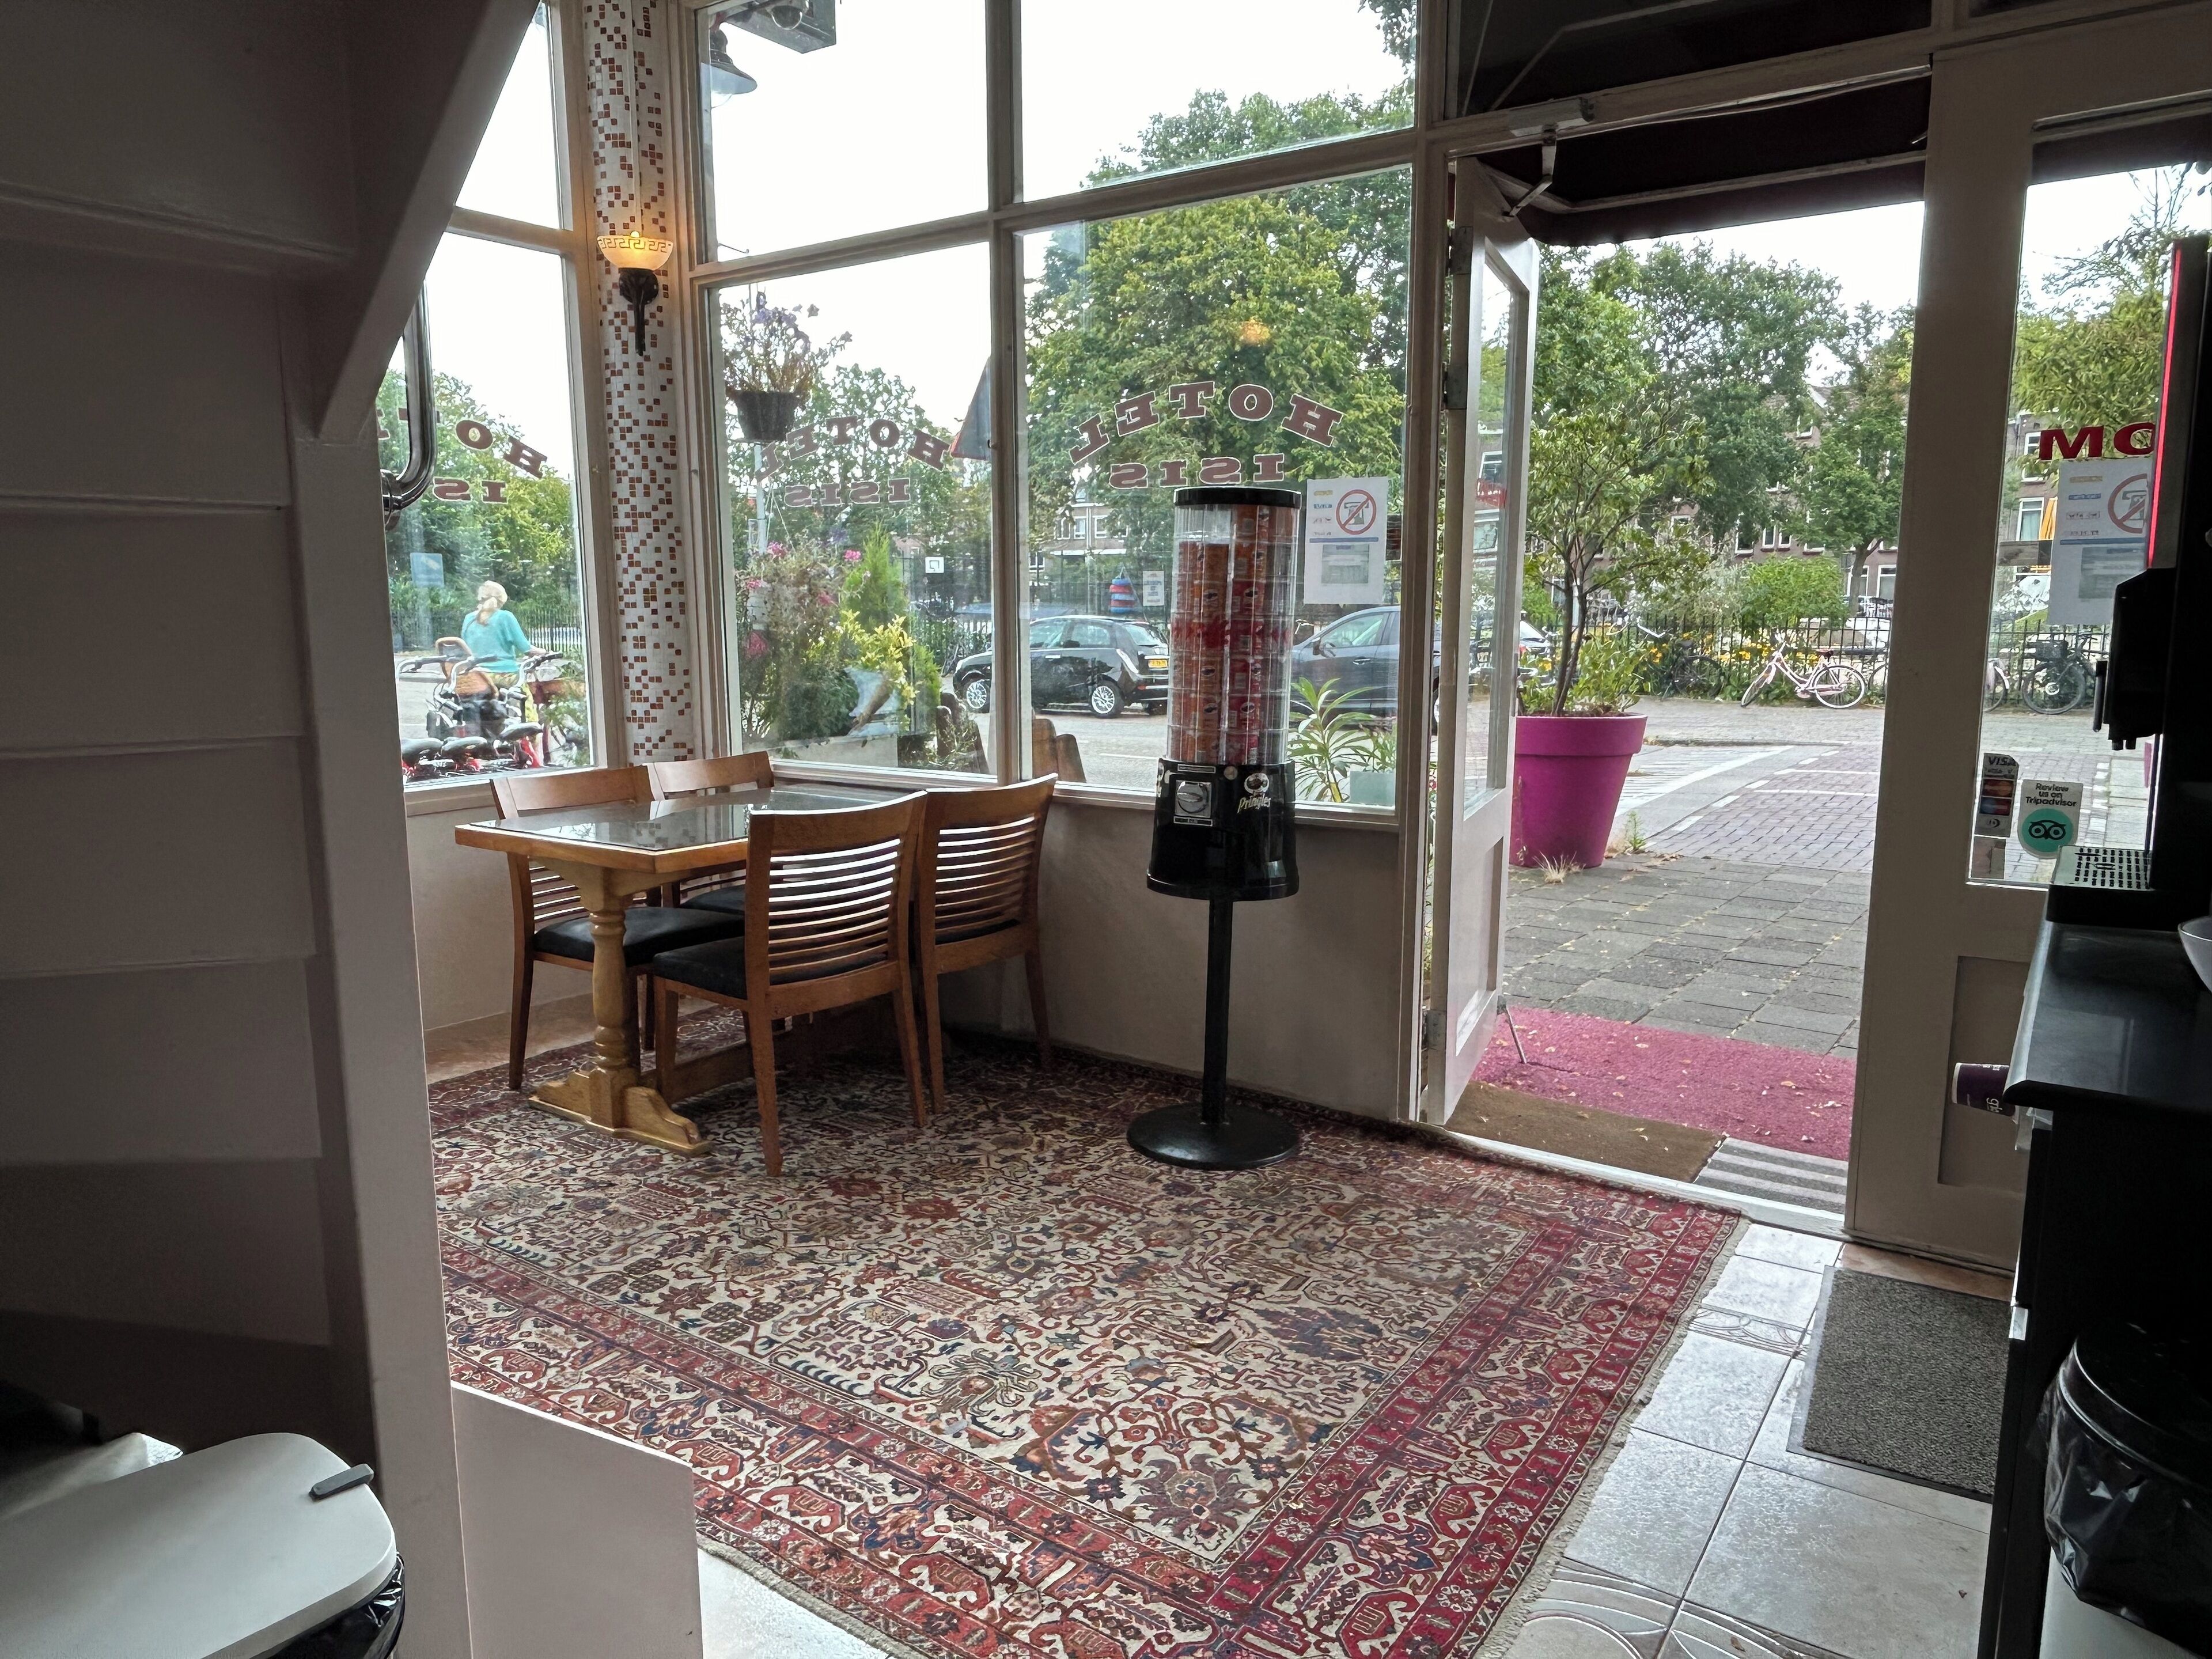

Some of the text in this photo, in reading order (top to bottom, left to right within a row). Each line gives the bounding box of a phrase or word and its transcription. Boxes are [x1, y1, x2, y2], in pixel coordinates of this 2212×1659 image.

[2035, 783, 2070, 792] Review
[1237, 792, 1271, 815] Pringles
[2026, 797, 2077, 807] Tripadvisor
